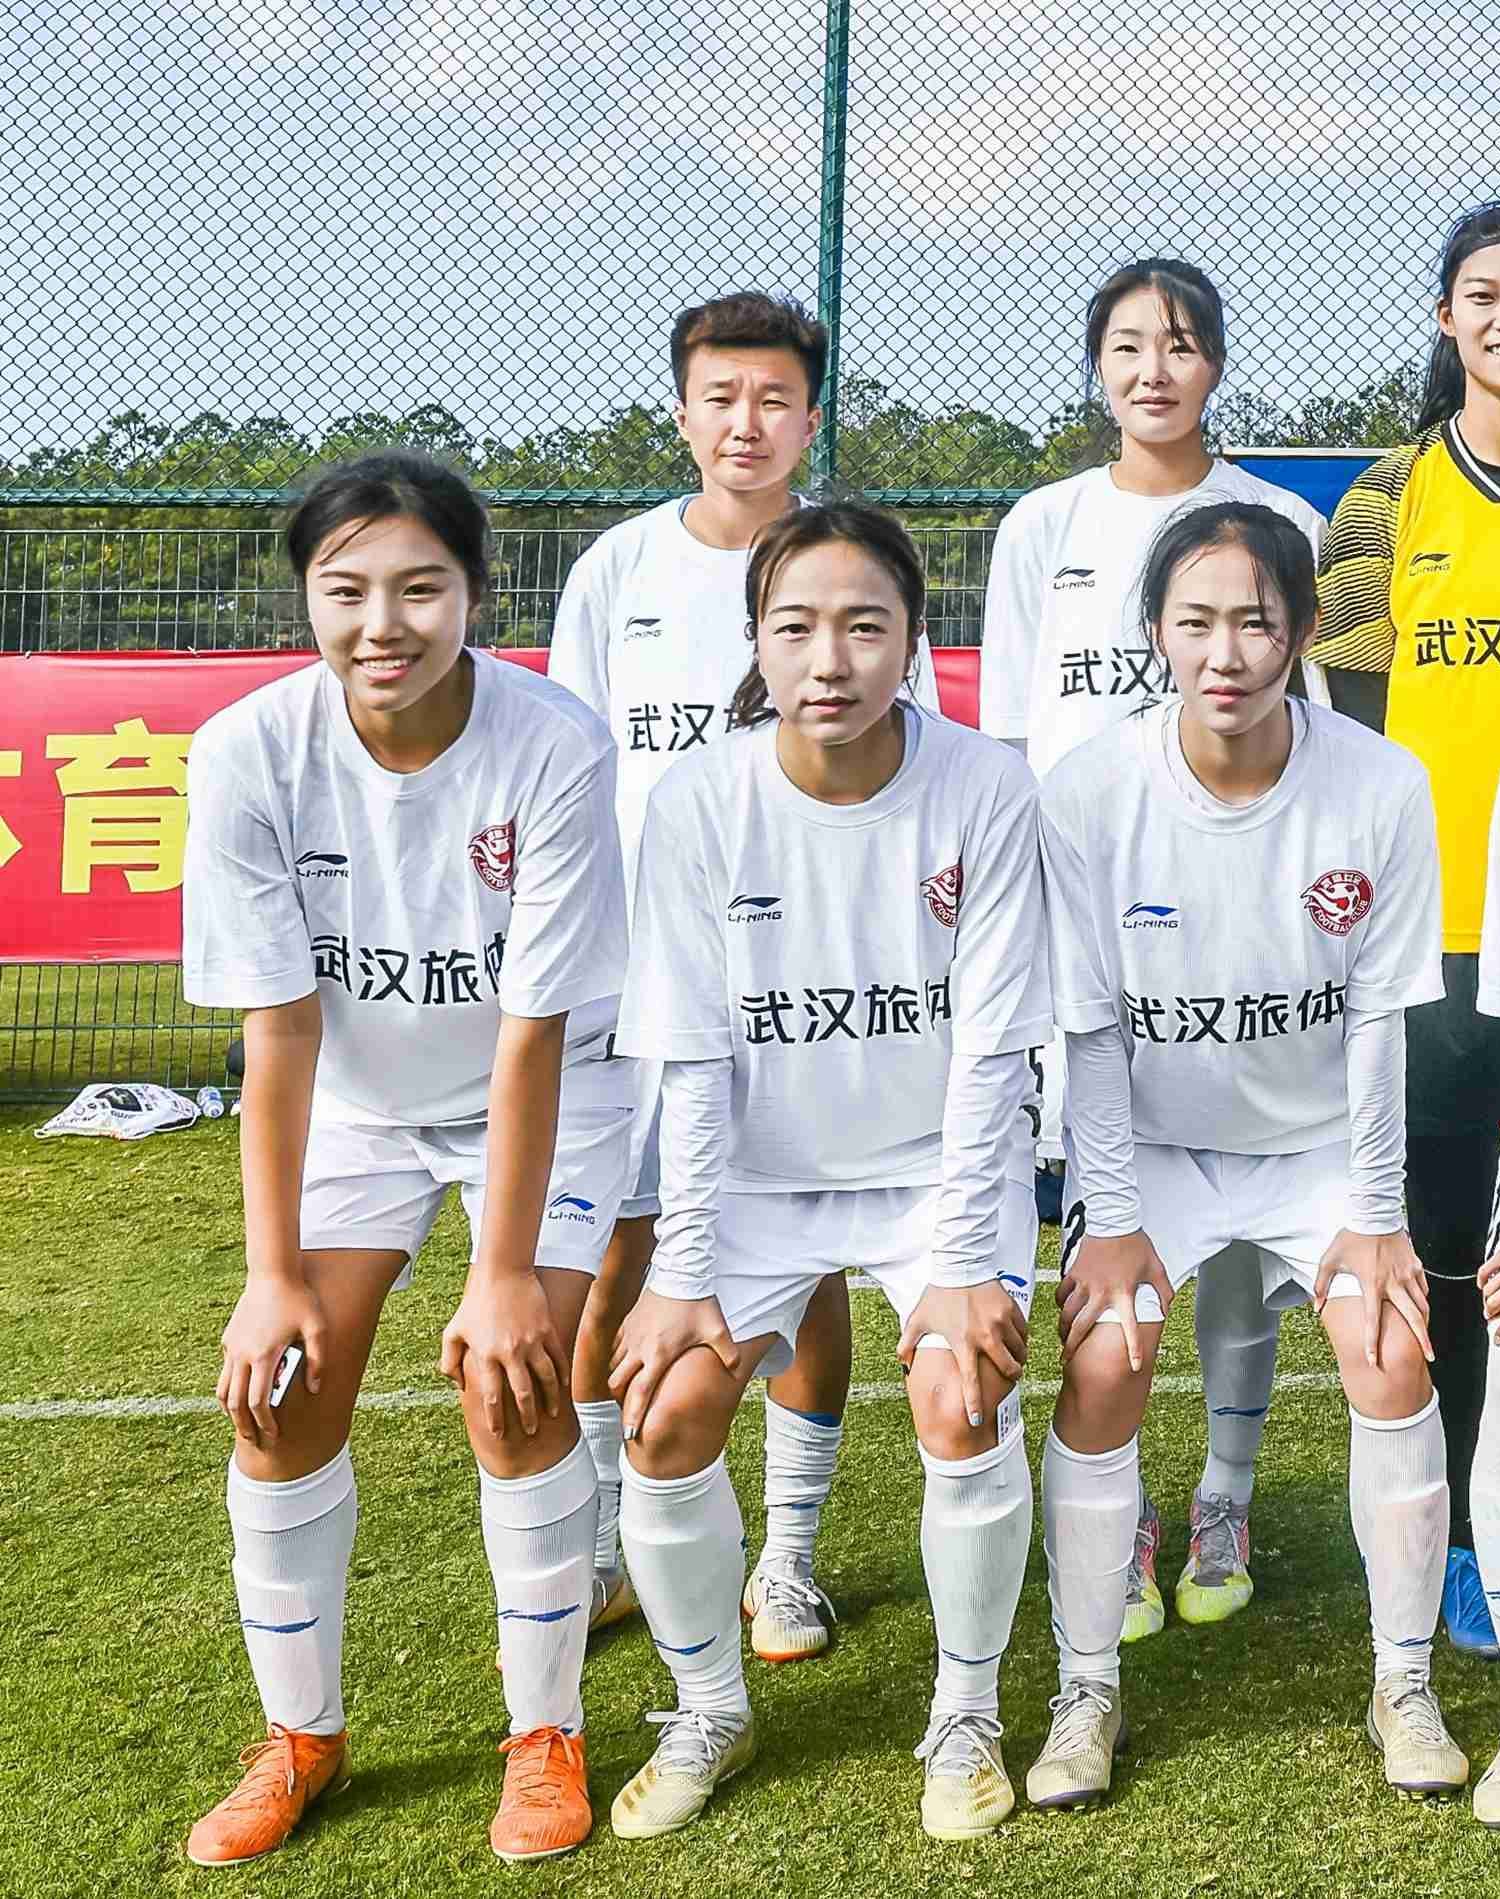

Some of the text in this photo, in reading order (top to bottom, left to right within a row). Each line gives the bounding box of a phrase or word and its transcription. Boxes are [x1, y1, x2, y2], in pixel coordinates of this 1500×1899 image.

[1053, 579, 1096, 591] LI-NING
[0, 716, 190, 894] 育
[296, 867, 349, 878] LI-NIN
[728, 910, 783, 923] LI-NING
[1122, 919, 1180, 930] LI-NING
[1122, 980, 1346, 1045] 武汉旅体
[548, 1210, 596, 1225] LI-NING
